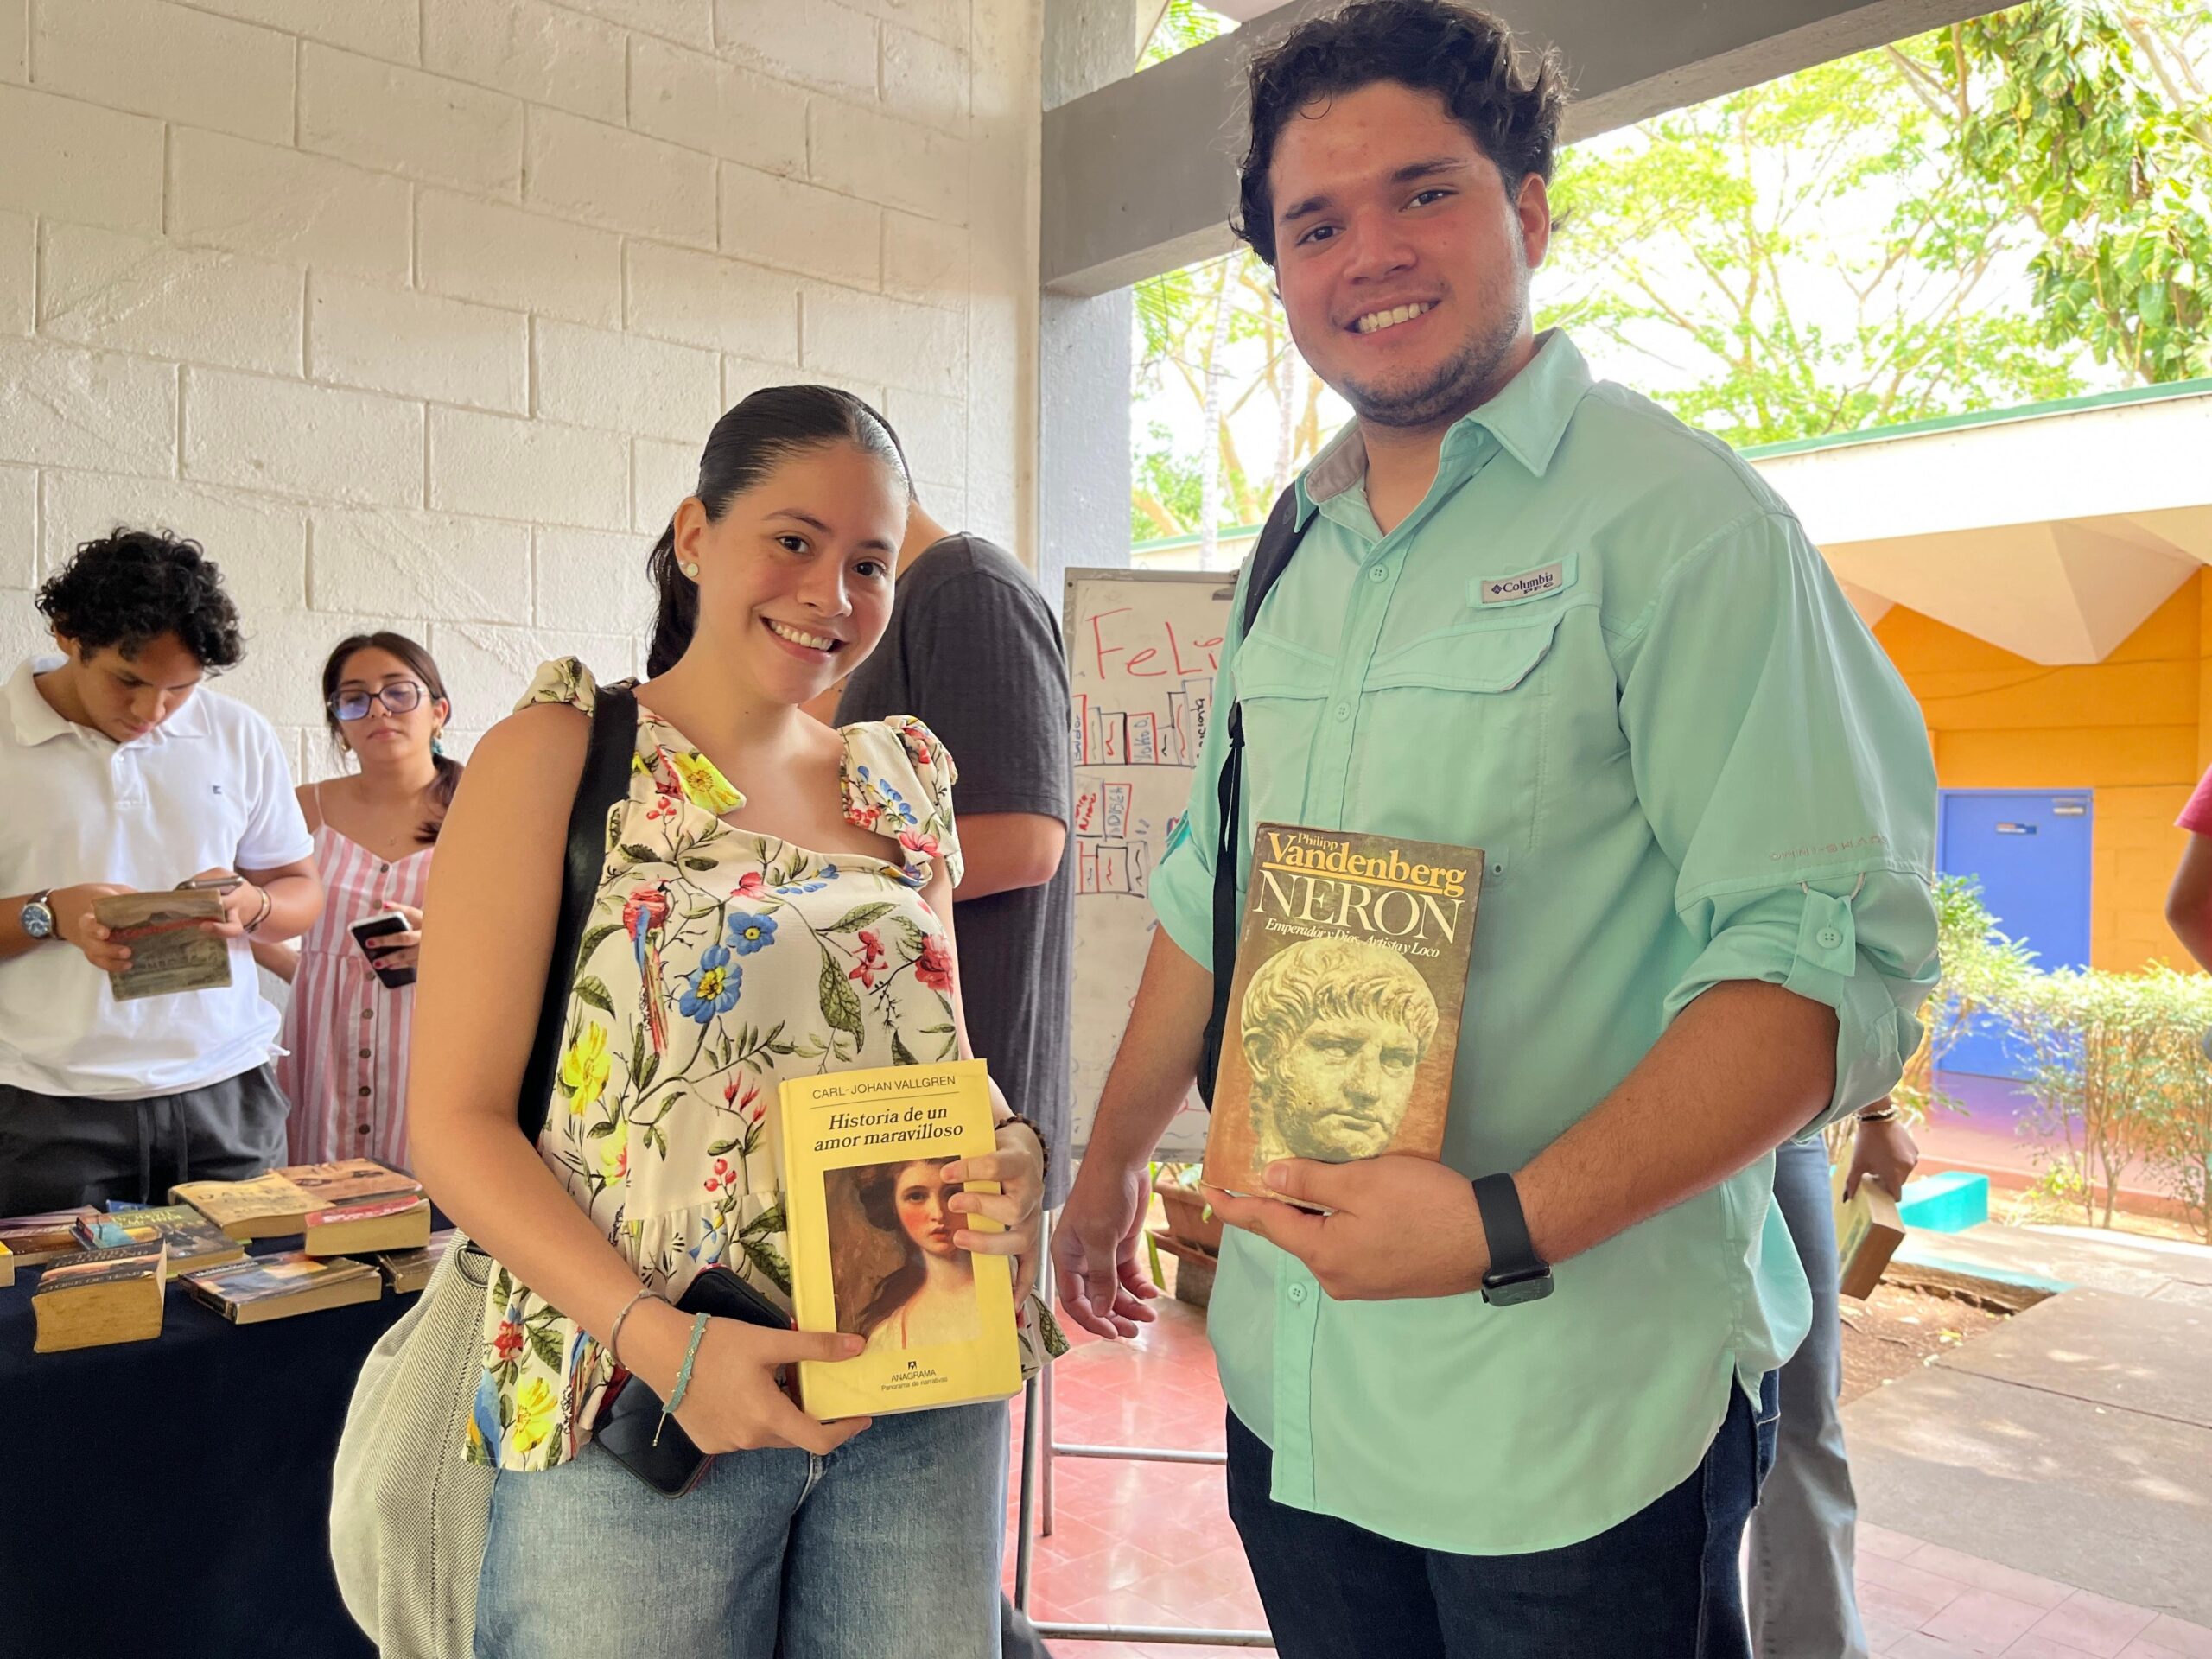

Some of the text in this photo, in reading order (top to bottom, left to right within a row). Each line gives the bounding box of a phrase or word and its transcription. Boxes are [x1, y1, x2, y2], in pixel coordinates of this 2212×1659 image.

[1503, 572, 1554, 592] Columbia
[1297, 832, 1338, 852] Philipp
[1268, 831, 1466, 897] Vandenberg
[1253, 869, 1466, 944] NERON
[1265, 918, 1326, 938] Emperador
[1410, 943, 1440, 958] Loco
[812, 1075, 956, 1100] CARL-JOHAN VALLGREN
[829, 1106, 948, 1130] Historia de un
[814, 1123, 963, 1152] amor maravilloso
[881, 1382, 911, 1392] Panorama
[920, 1376, 948, 1387] narrativas
[891, 1369, 937, 1382] ANAGRAMA
